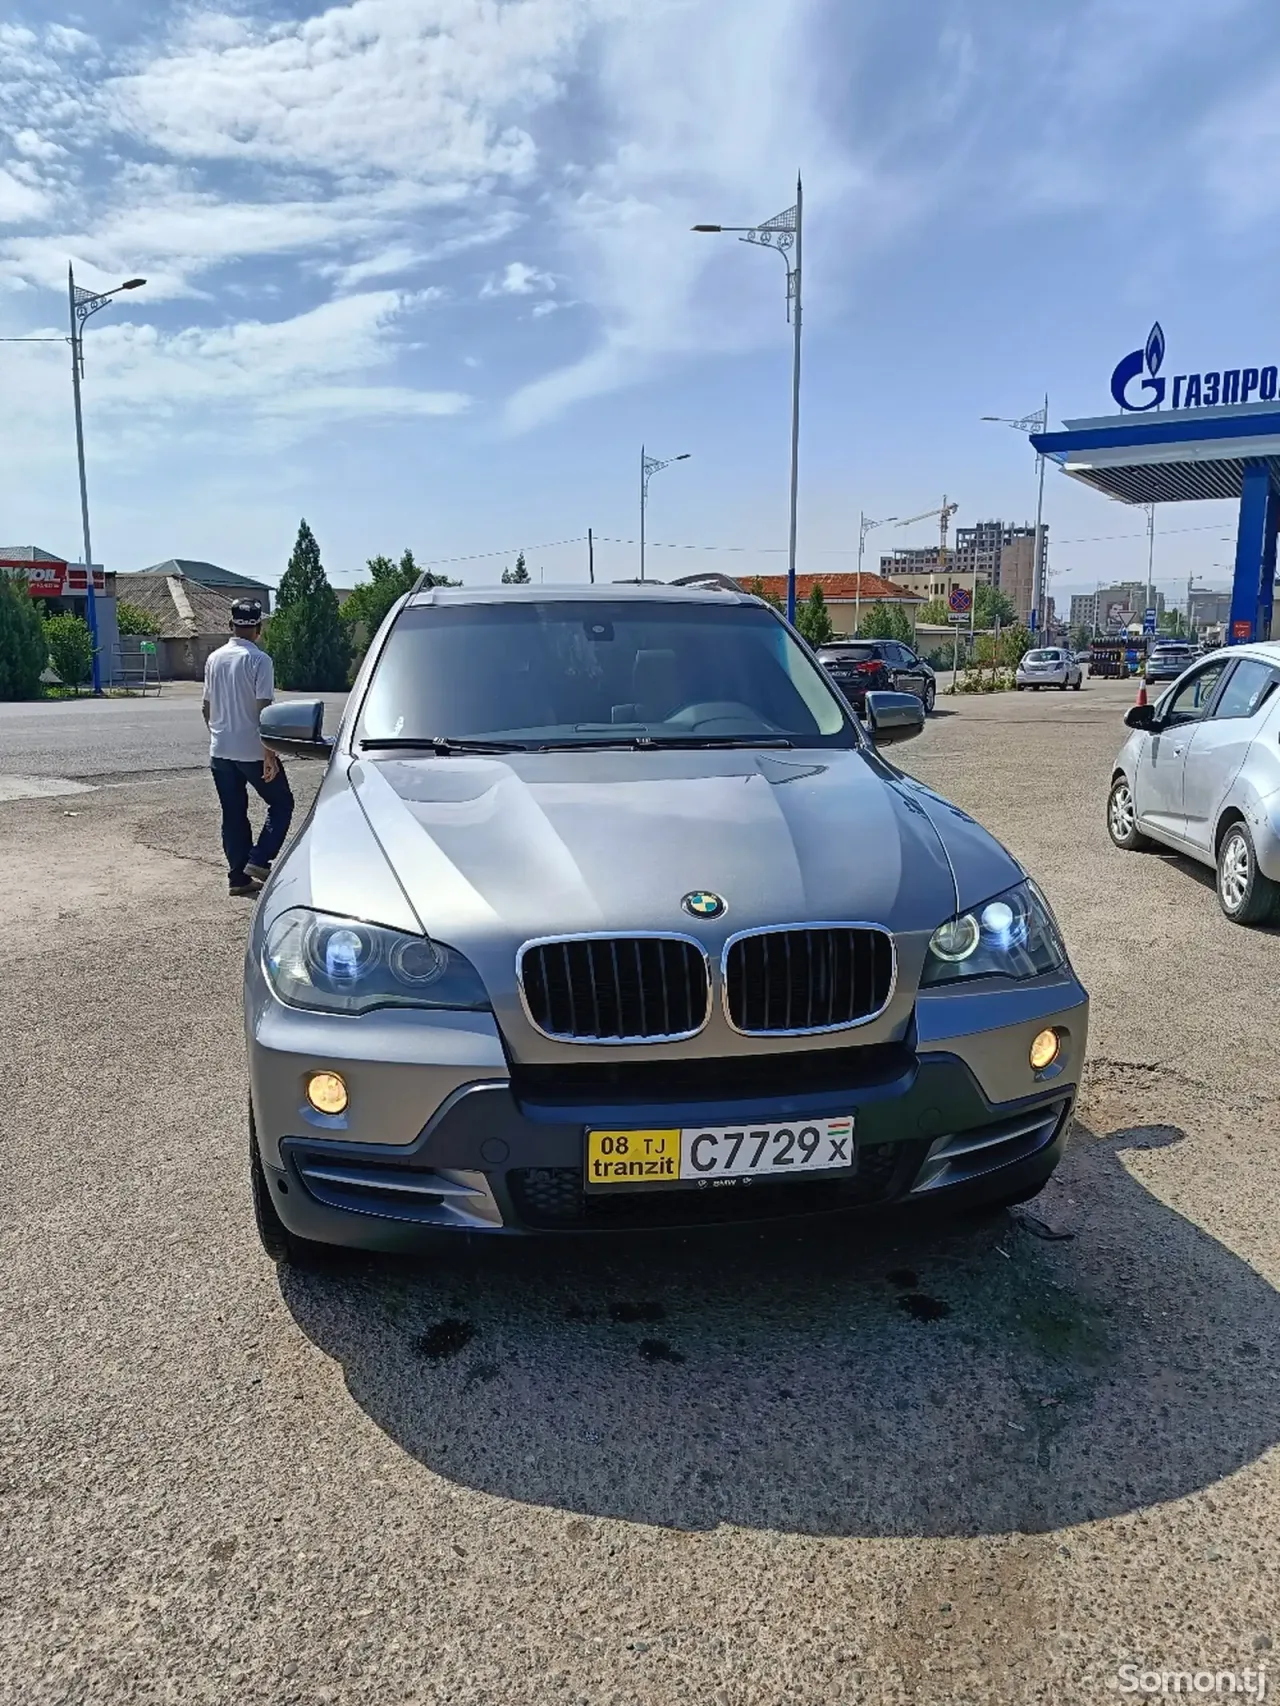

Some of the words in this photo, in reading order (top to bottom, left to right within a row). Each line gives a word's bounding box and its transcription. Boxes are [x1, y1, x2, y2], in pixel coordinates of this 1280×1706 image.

[1172, 365, 1280, 409] ГАЗПРО
[601, 1136, 629, 1155] 08
[643, 1138, 665, 1155] TJ
[690, 1126, 820, 1172] C7729
[593, 1157, 674, 1177] tranzit
